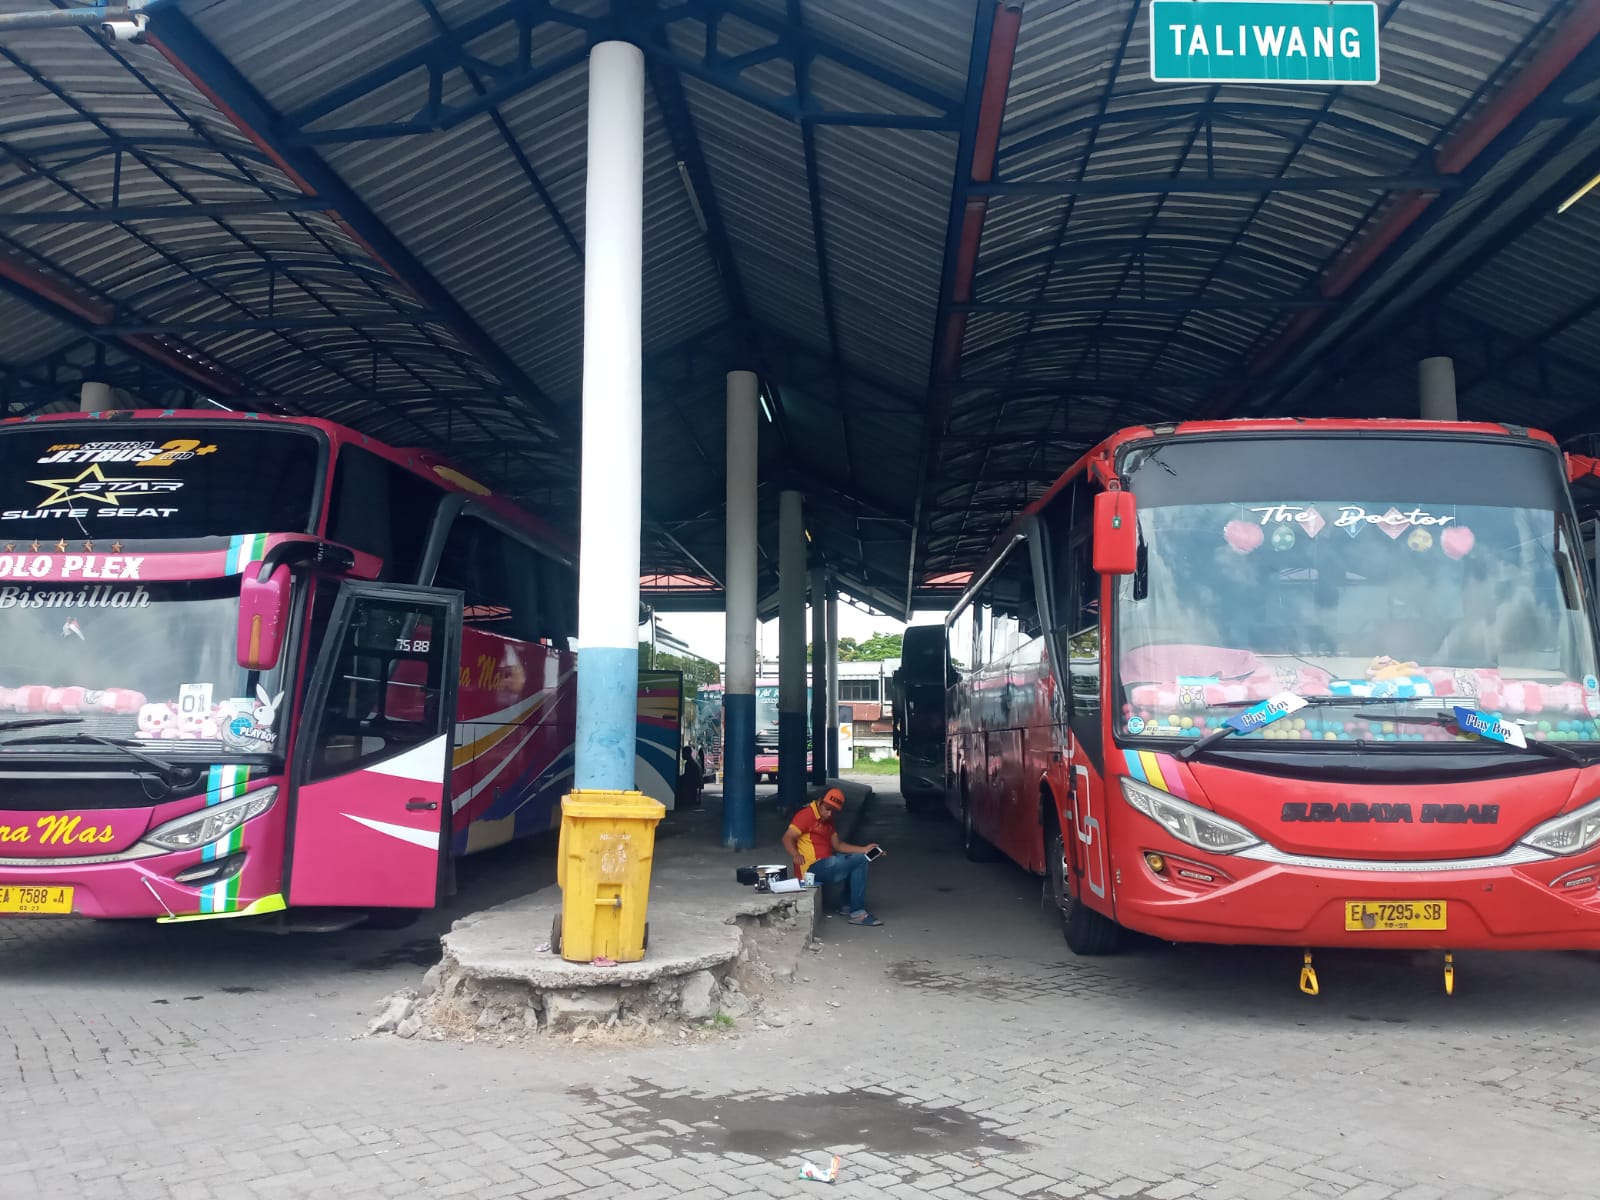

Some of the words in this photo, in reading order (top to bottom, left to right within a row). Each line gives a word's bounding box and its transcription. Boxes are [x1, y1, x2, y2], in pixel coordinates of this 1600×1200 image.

[1169, 24, 1361, 58] TALIWANG
[36, 449, 163, 464] JETBUS
[74, 482, 184, 492] STAR
[0, 509, 89, 520] SUITE
[96, 507, 178, 517] SEAT
[1250, 504, 1318, 526] The
[1334, 505, 1456, 528] Doctor
[61, 555, 145, 579] PLEX
[0, 584, 152, 609] Bismillah
[182, 694, 205, 713] 01
[1241, 709, 1267, 727] Play
[1267, 700, 1289, 715] Boy
[239, 726, 278, 743] PLAYBOY
[1466, 713, 1490, 733] Play
[1492, 721, 1513, 740] Boy
[37, 815, 115, 845] Mas
[19, 888, 48, 904] 7588
[58, 889, 65, 904] A
[1378, 904, 1414, 921] 7295
[1423, 903, 1442, 921] SB
